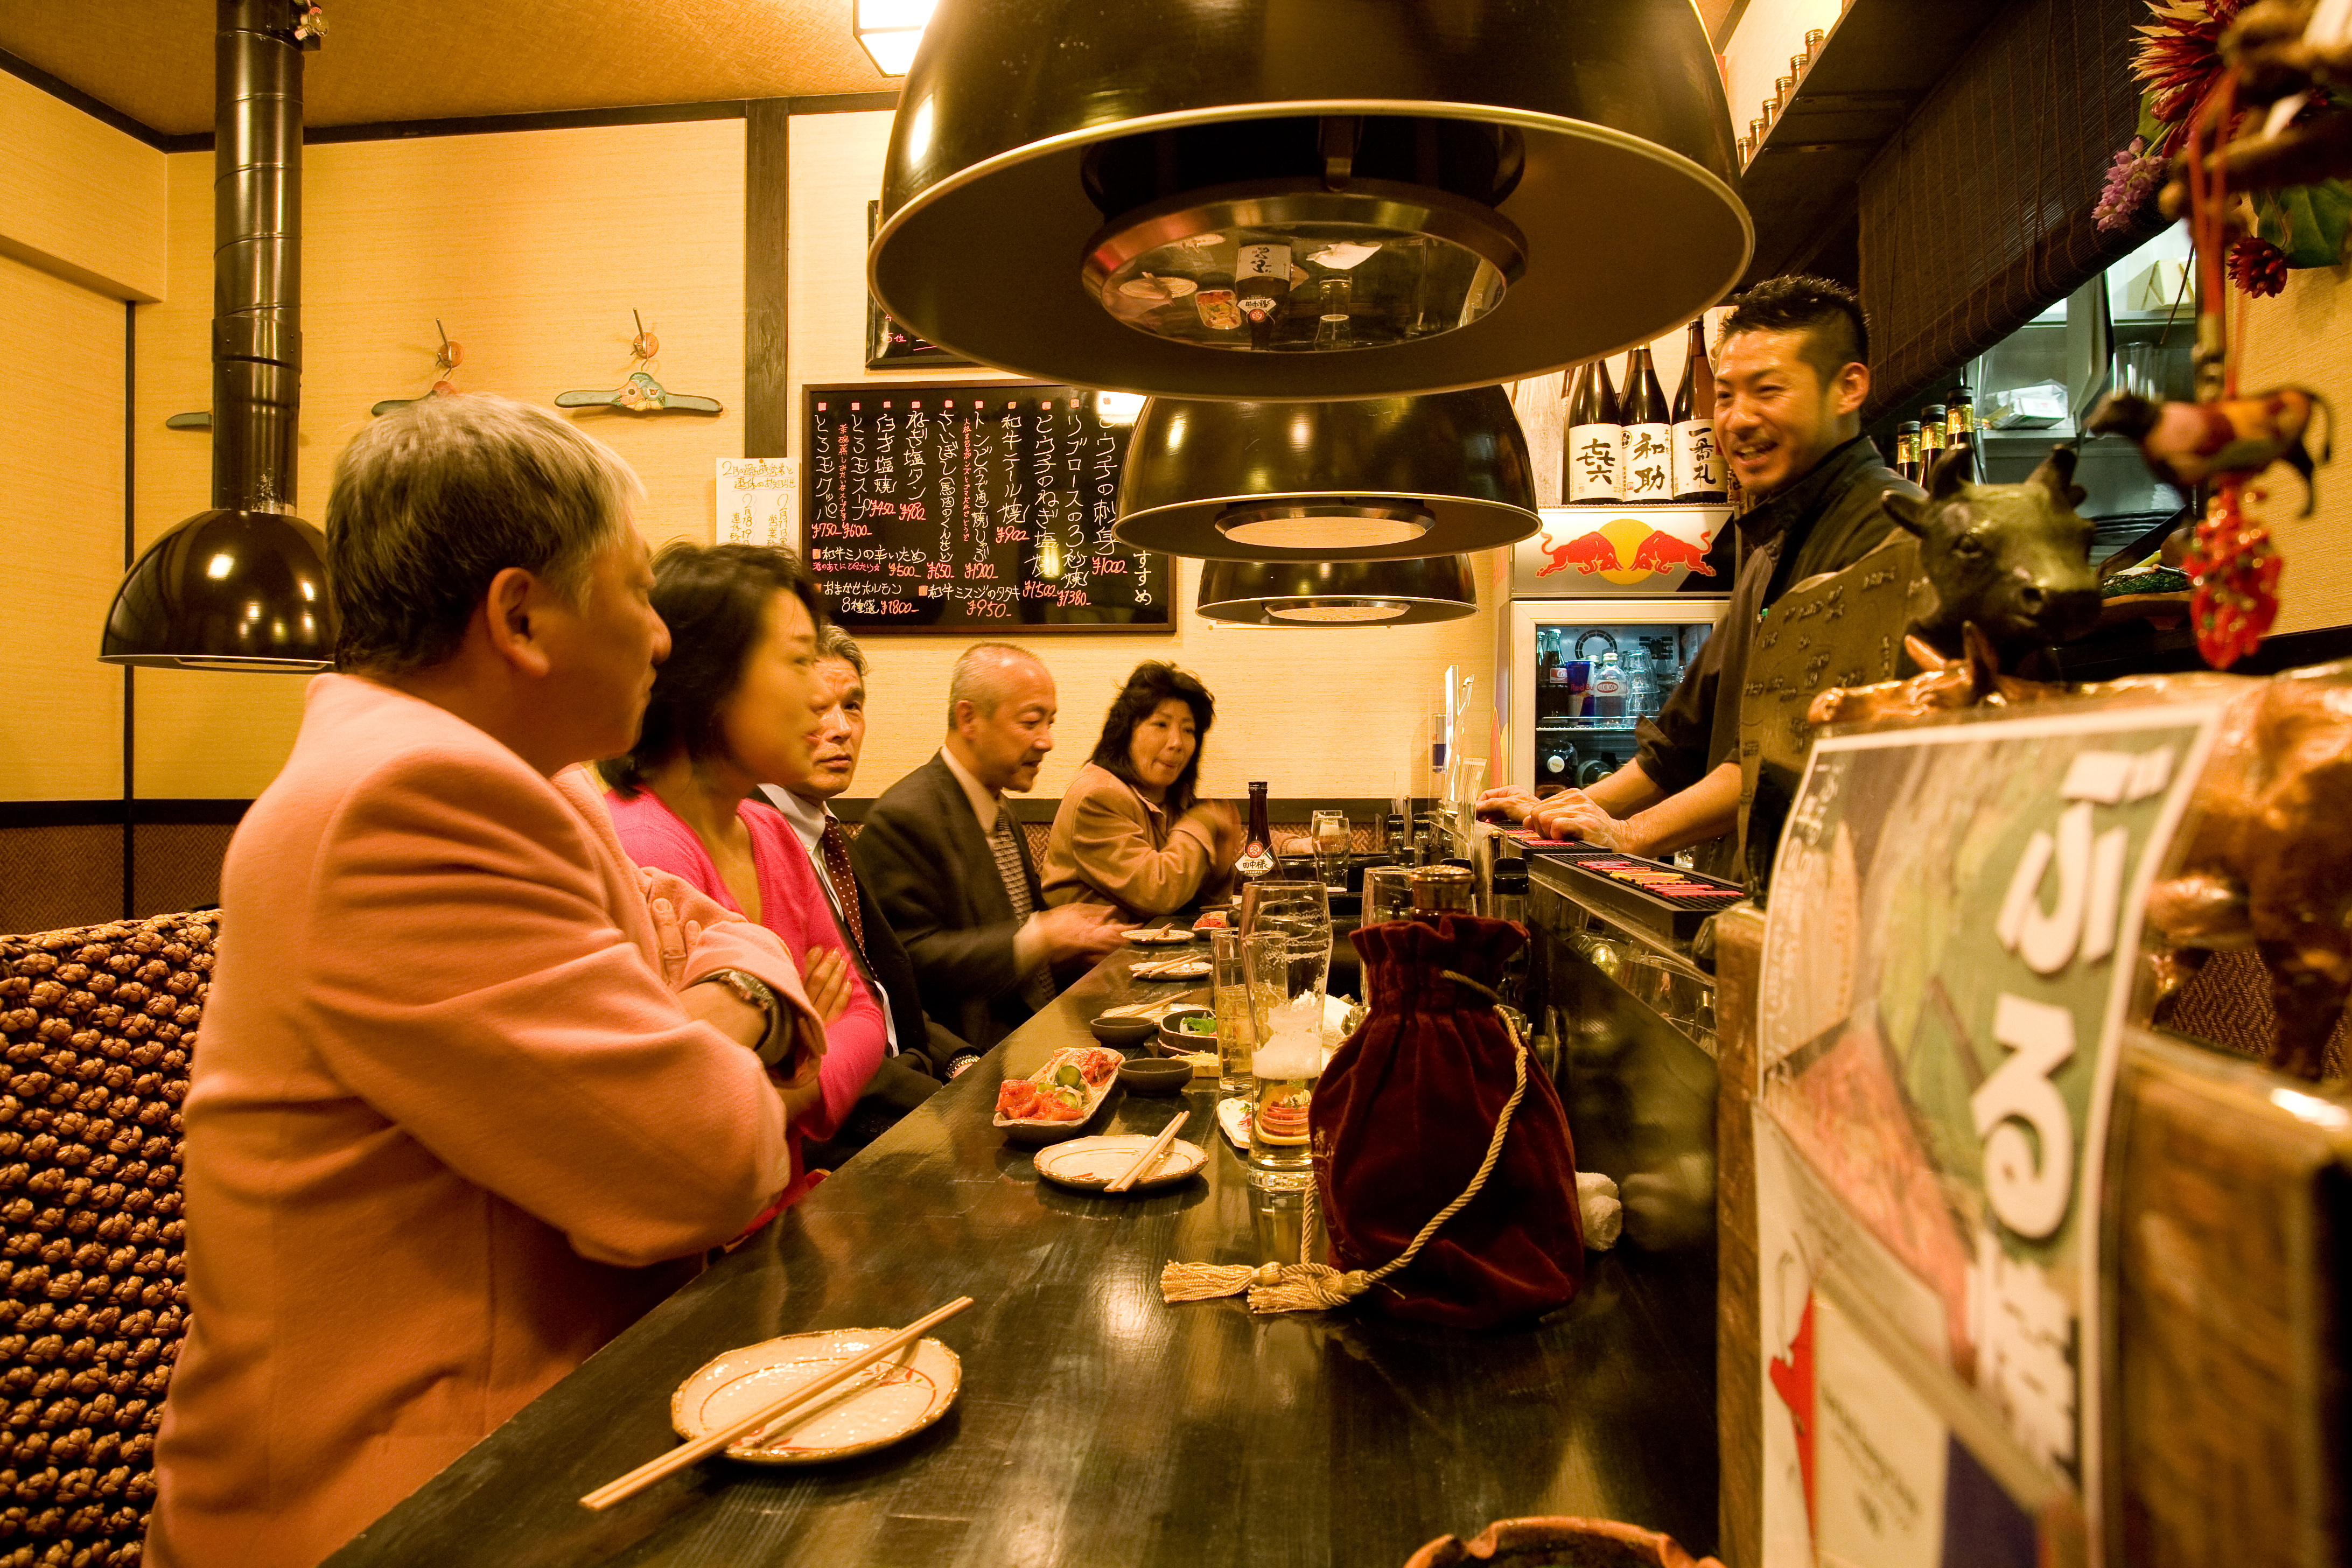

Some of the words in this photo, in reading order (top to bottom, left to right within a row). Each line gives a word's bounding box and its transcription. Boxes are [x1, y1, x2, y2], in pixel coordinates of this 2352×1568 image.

[734, 477, 796, 489] 連休のお知らせ
[814, 415, 837, 520] とろ玉クッパ
[851, 414, 871, 521] とろ玉スープ
[904, 410, 930, 500] ねぎ塩タン
[997, 414, 1030, 524] 和牛テール焼
[1632, 432, 1665, 493] 和助
[1688, 428, 1717, 488] 一番札
[823, 580, 902, 595] おまかせホルモン
[1557, 670, 1567, 678] Co
